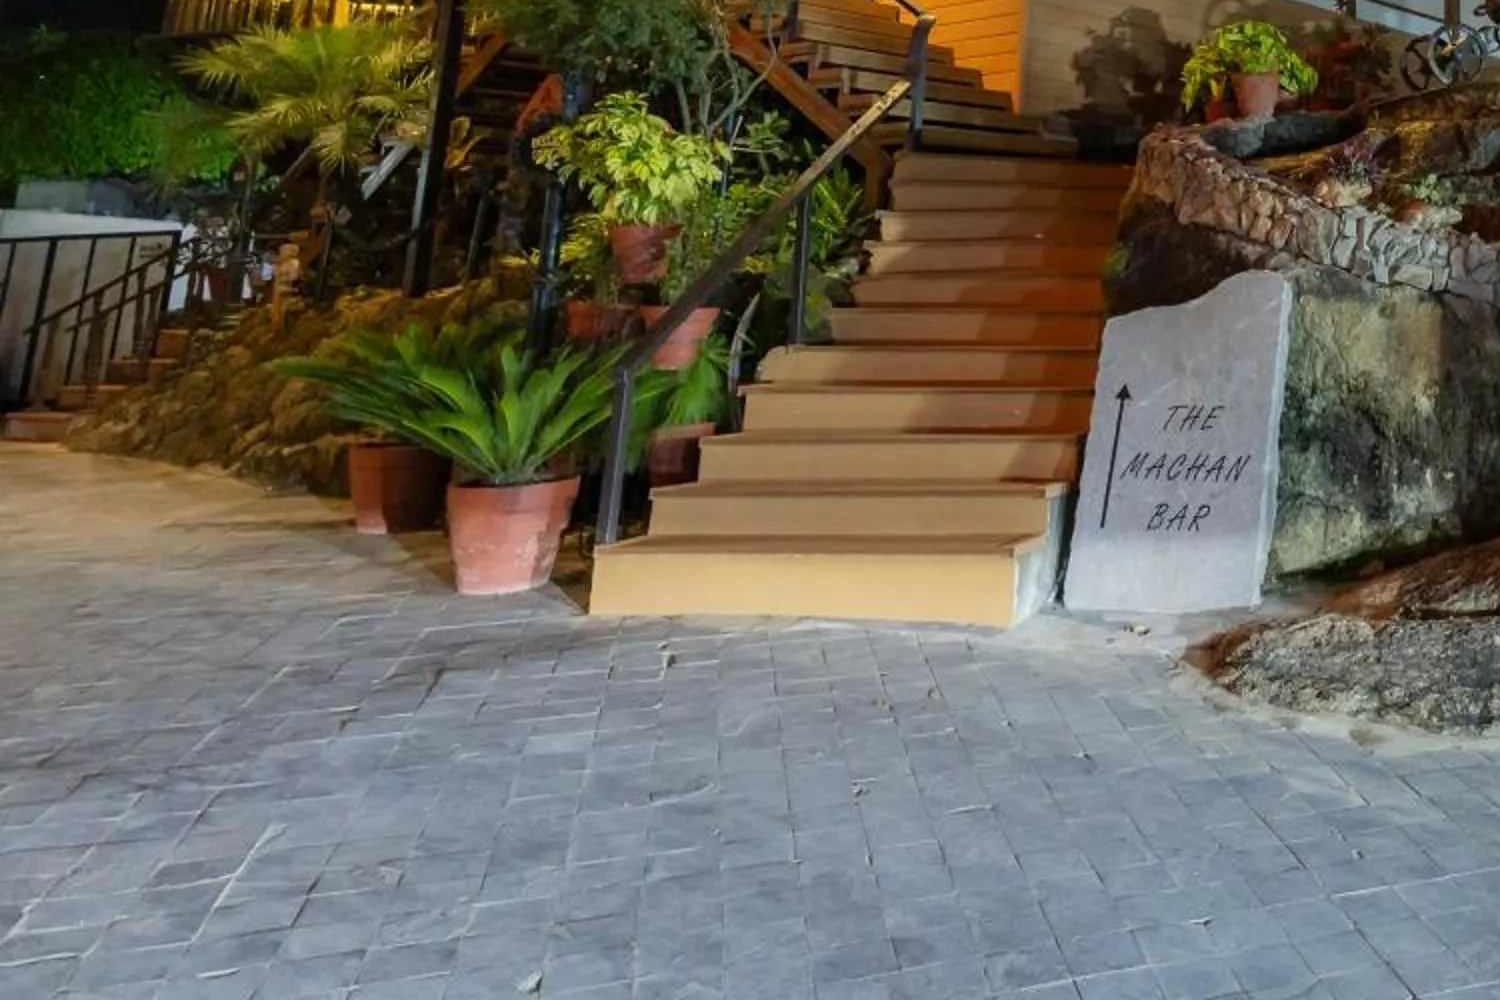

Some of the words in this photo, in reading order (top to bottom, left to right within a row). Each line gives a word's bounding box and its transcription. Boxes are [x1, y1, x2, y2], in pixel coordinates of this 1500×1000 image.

[1163, 405, 1224, 432] THE
[1120, 452, 1252, 482] MACHAN
[1147, 504, 1211, 532] BAR
